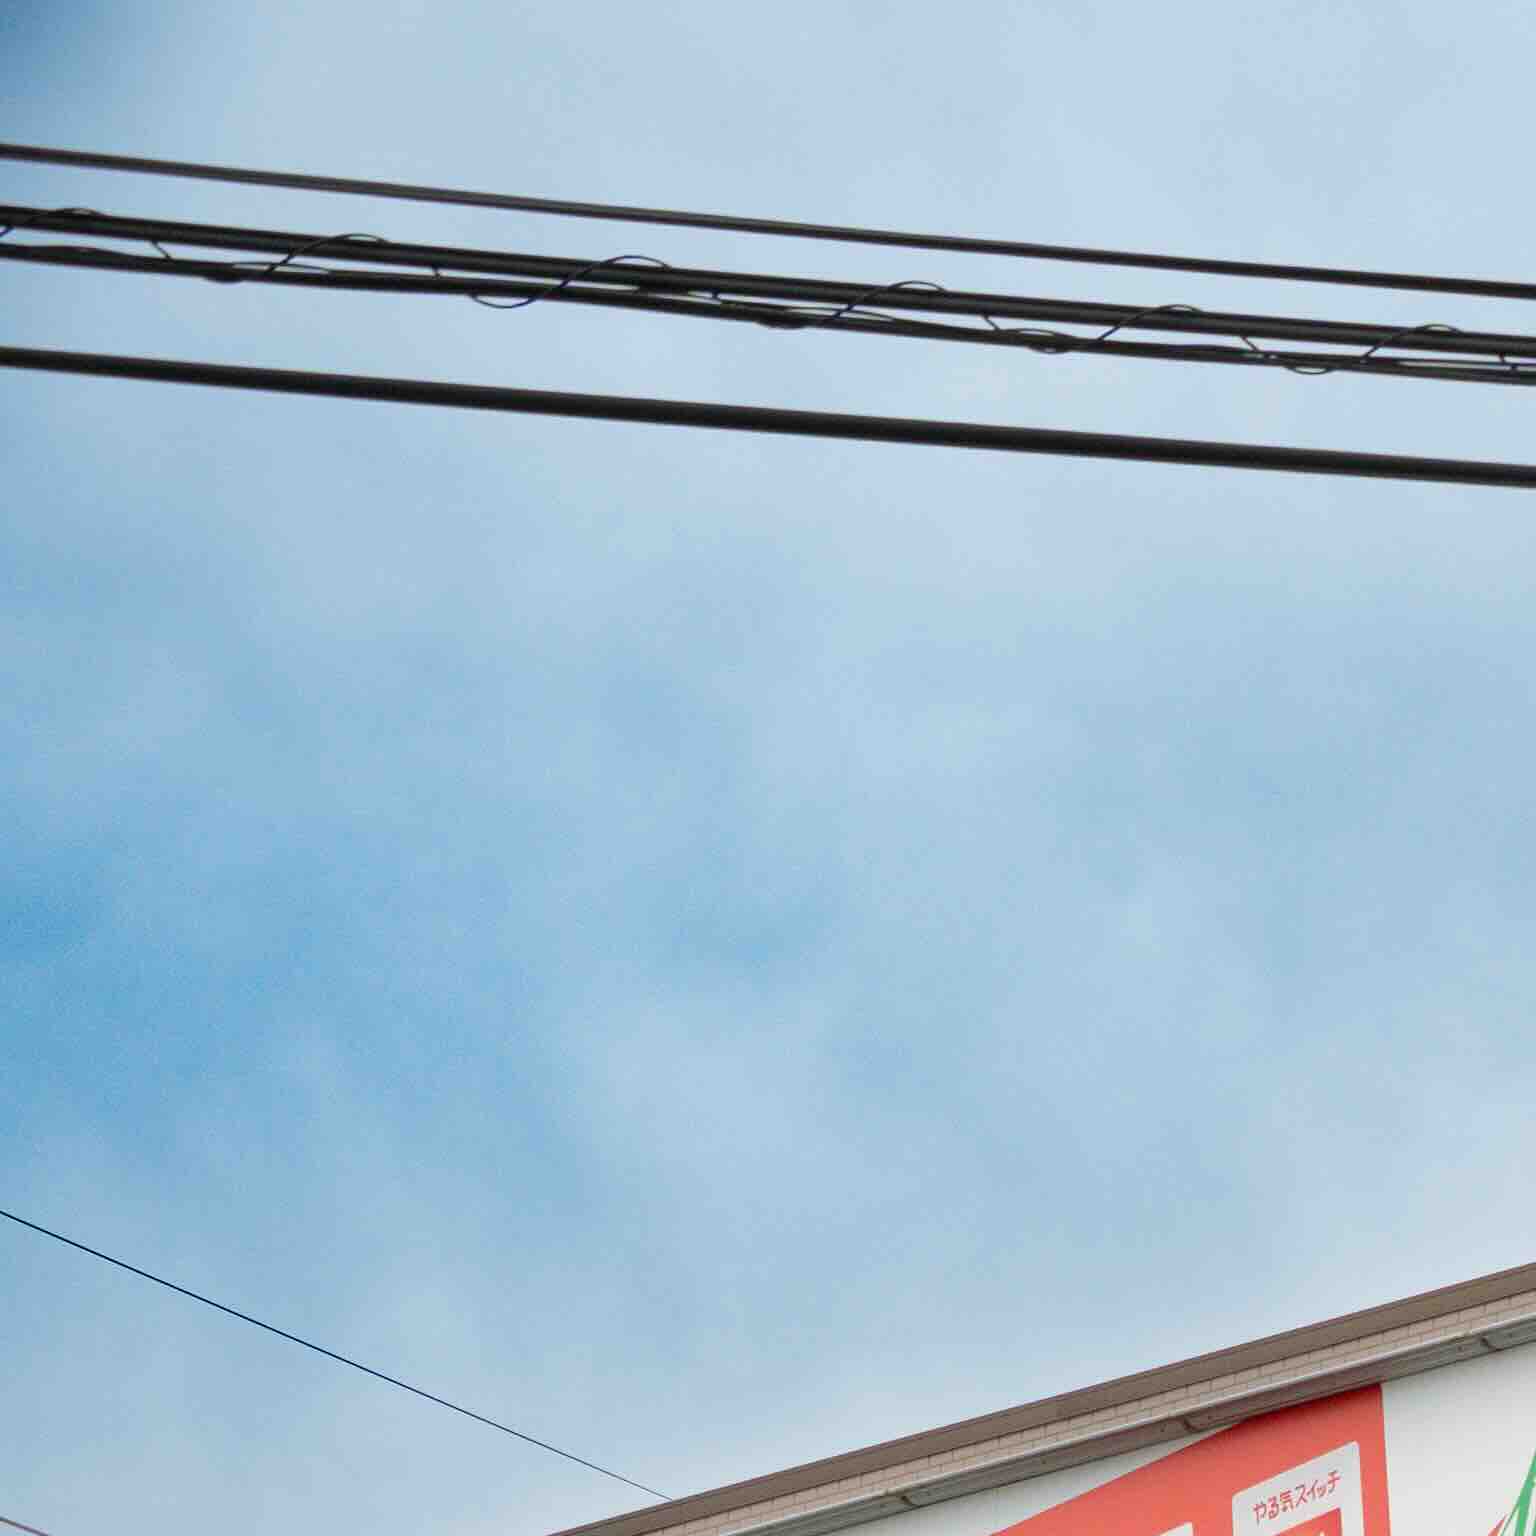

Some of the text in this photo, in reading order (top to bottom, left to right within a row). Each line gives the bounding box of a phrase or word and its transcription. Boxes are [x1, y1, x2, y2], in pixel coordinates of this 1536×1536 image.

[1253, 1469, 1341, 1527] やる気スイッチ
